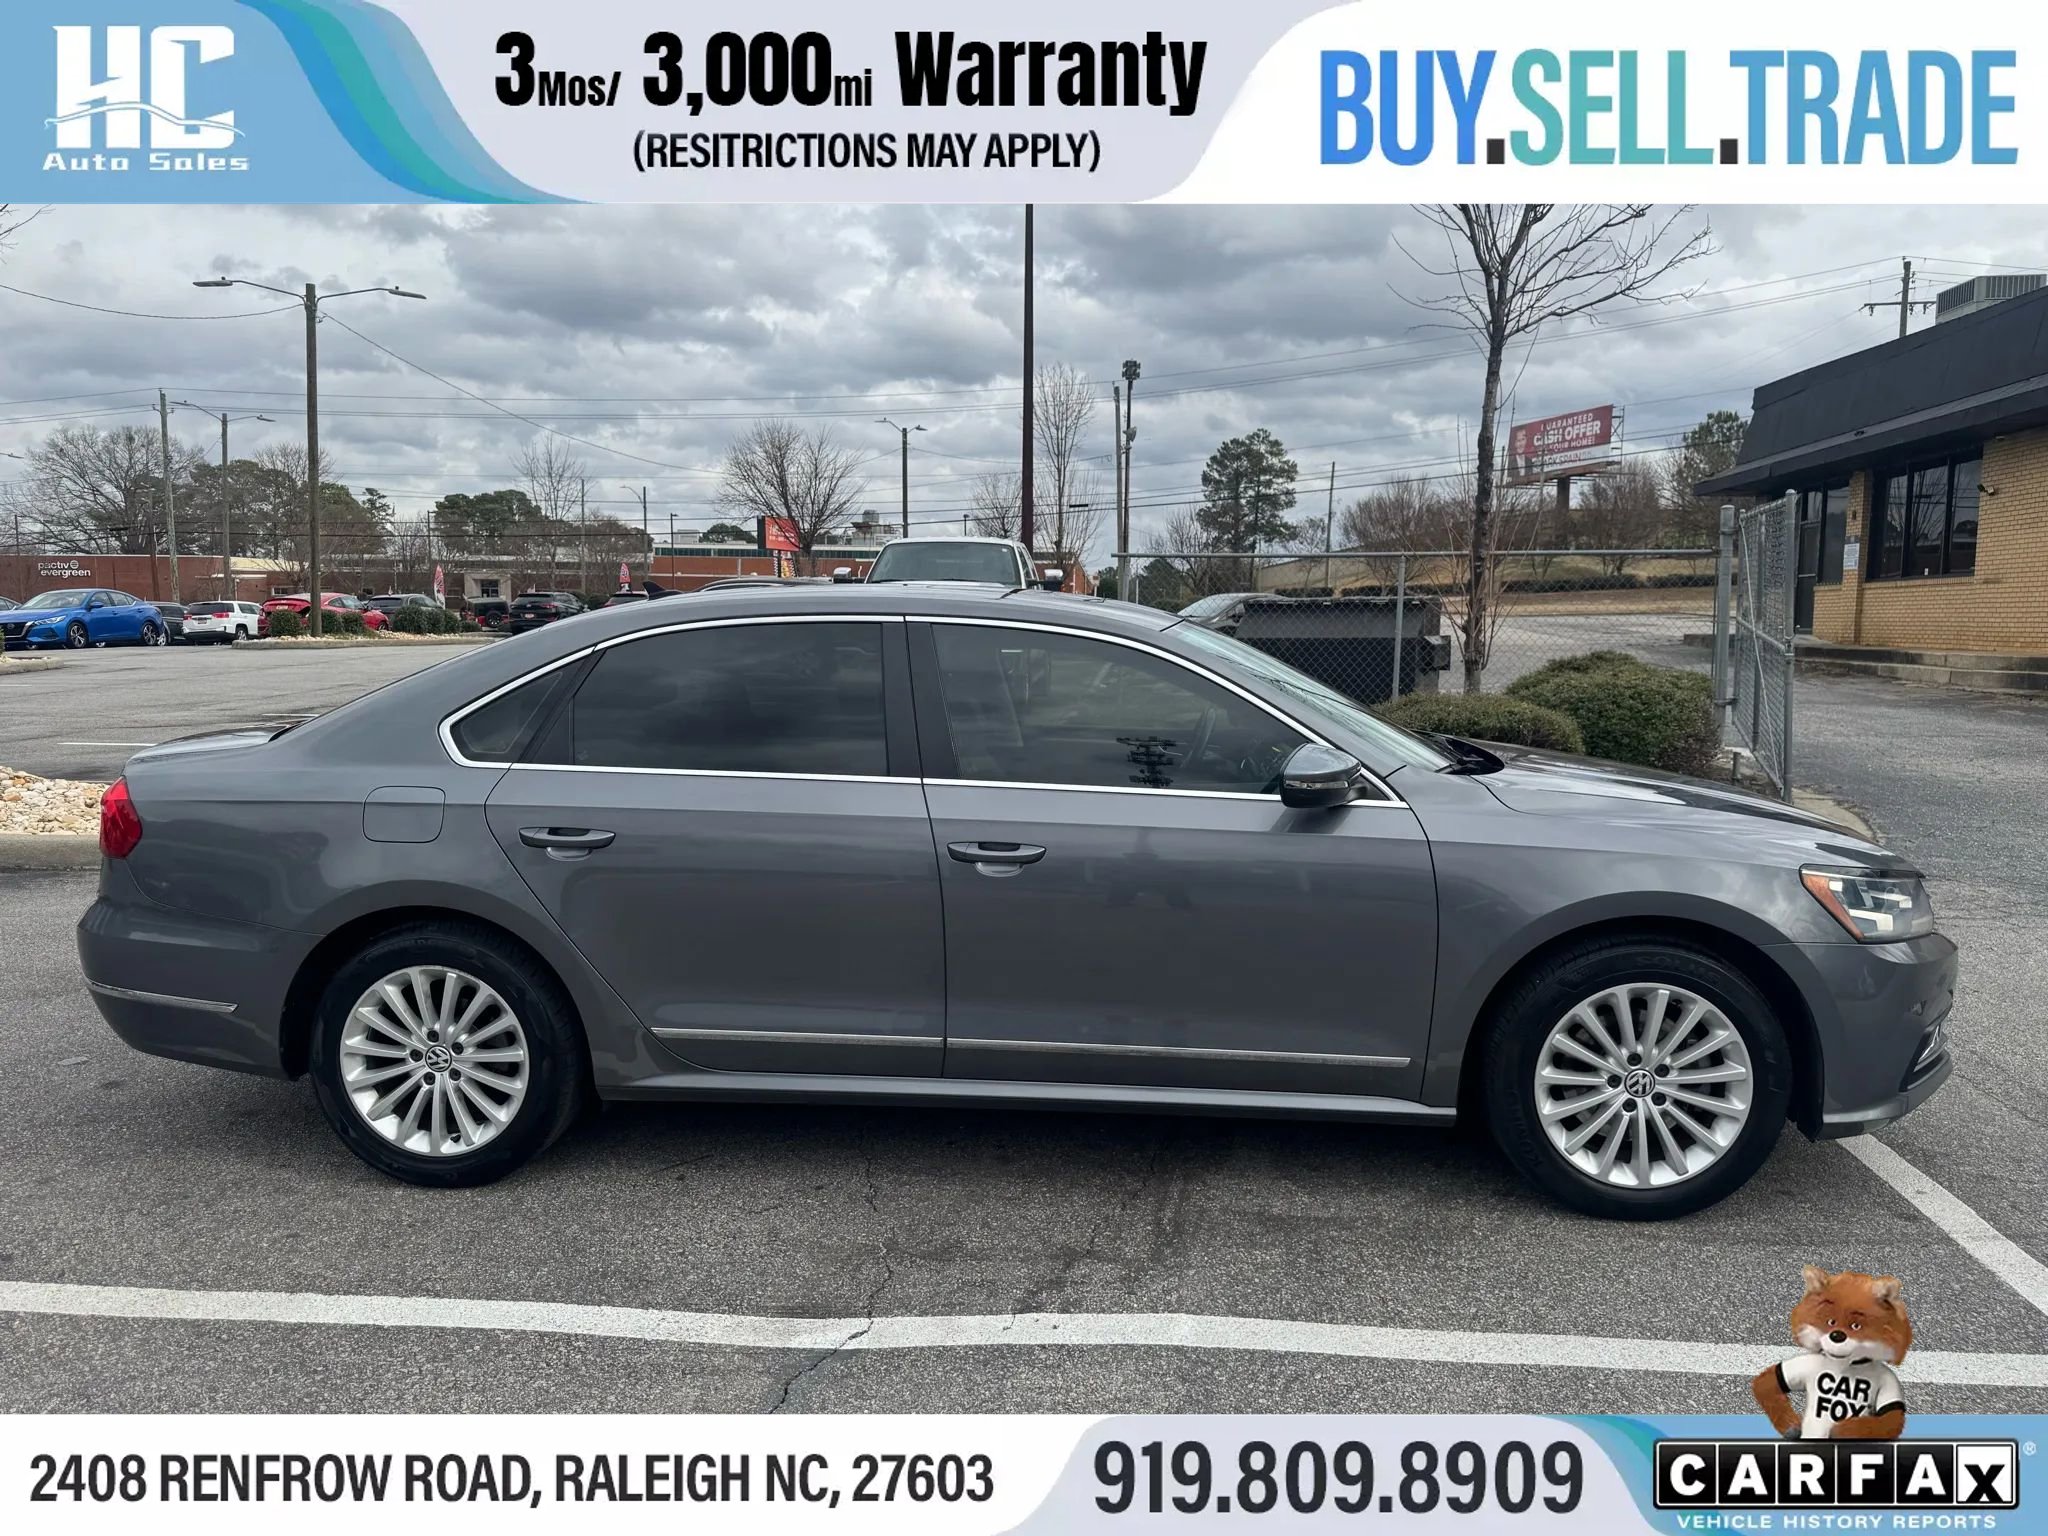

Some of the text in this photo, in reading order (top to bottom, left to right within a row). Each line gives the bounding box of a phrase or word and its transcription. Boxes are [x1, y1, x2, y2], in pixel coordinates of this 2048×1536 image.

[1564, 420, 1601, 440] OFFER
[38, 561, 69, 570] pactiv
[40, 569, 91, 578] evergreen
